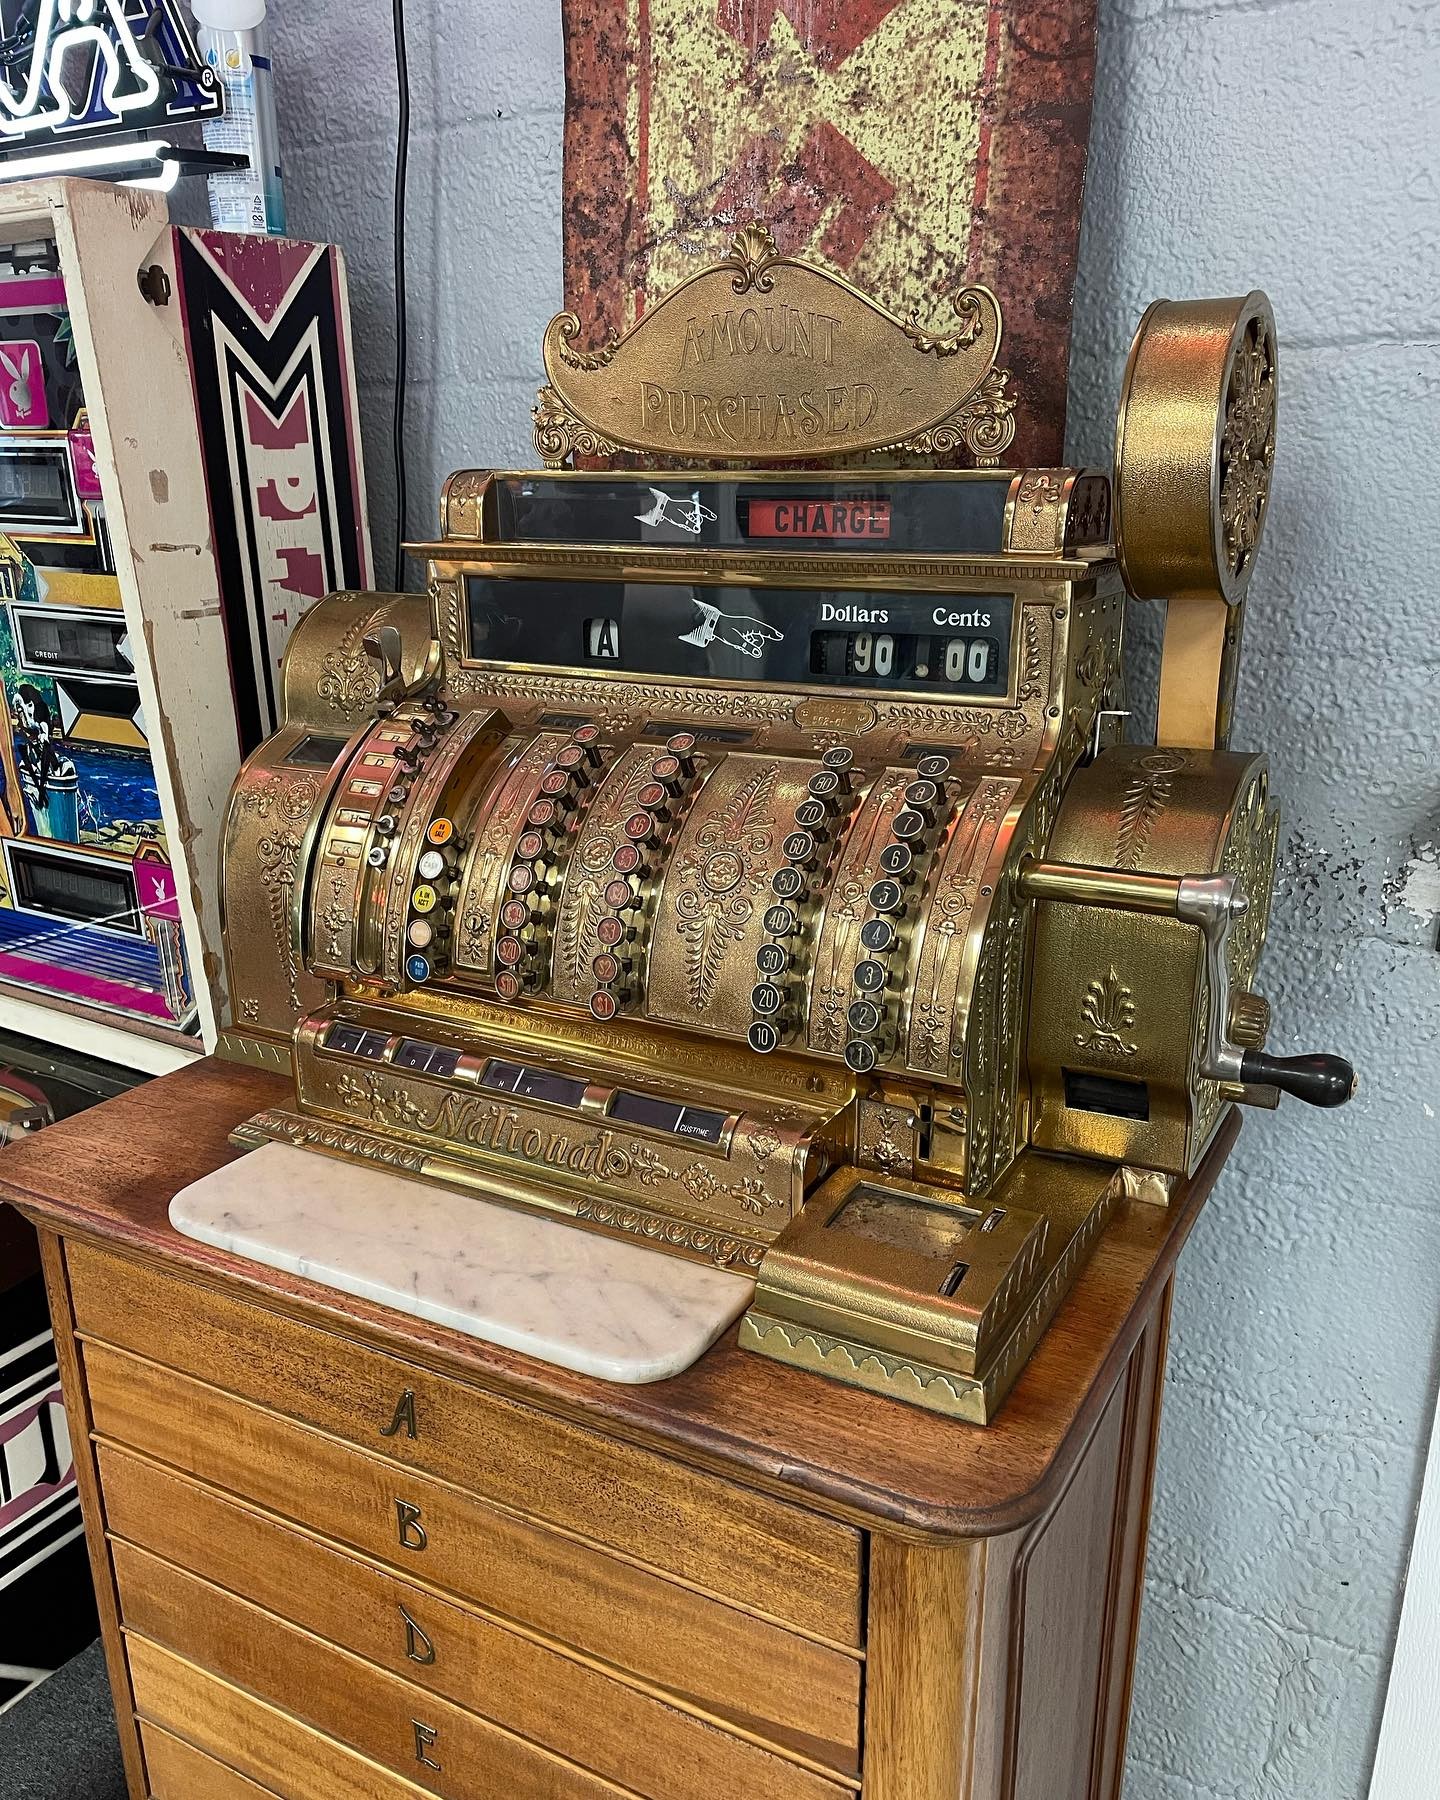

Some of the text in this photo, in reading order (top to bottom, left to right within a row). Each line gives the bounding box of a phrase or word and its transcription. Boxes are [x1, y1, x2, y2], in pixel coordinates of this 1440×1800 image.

[679, 304, 842, 373] AMOUNT
[638, 381, 879, 443] PURCHASED
[774, 504, 886, 535] CHARGE
[820, 603, 992, 628] Dollars Cents
[598, 619, 616, 657] A
[34, 649, 59, 660] CREDIT
[854, 632, 895, 676] 90
[375, 757, 385, 767] D
[830, 752, 847, 763] 90
[814, 776, 831, 789] 80
[801, 805, 818, 822] 70
[630, 818, 645, 834] $6
[789, 839, 806, 855] 60
[778, 873, 795, 891] 50
[768, 910, 784, 925] 40
[502, 941, 517, 960] $20
[763, 949, 779, 970] 30
[598, 960, 612, 977] $2
[500, 977, 516, 995] $10
[596, 996, 610, 1015] $1
[759, 989, 774, 1008] 20
[757, 1027, 769, 1046] 10
[417, 1091, 632, 1181] National
[379, 1388, 418, 1441] A
[393, 1496, 427, 1552] B
[398, 1603, 436, 1666] D
[411, 1717, 441, 1771] E
